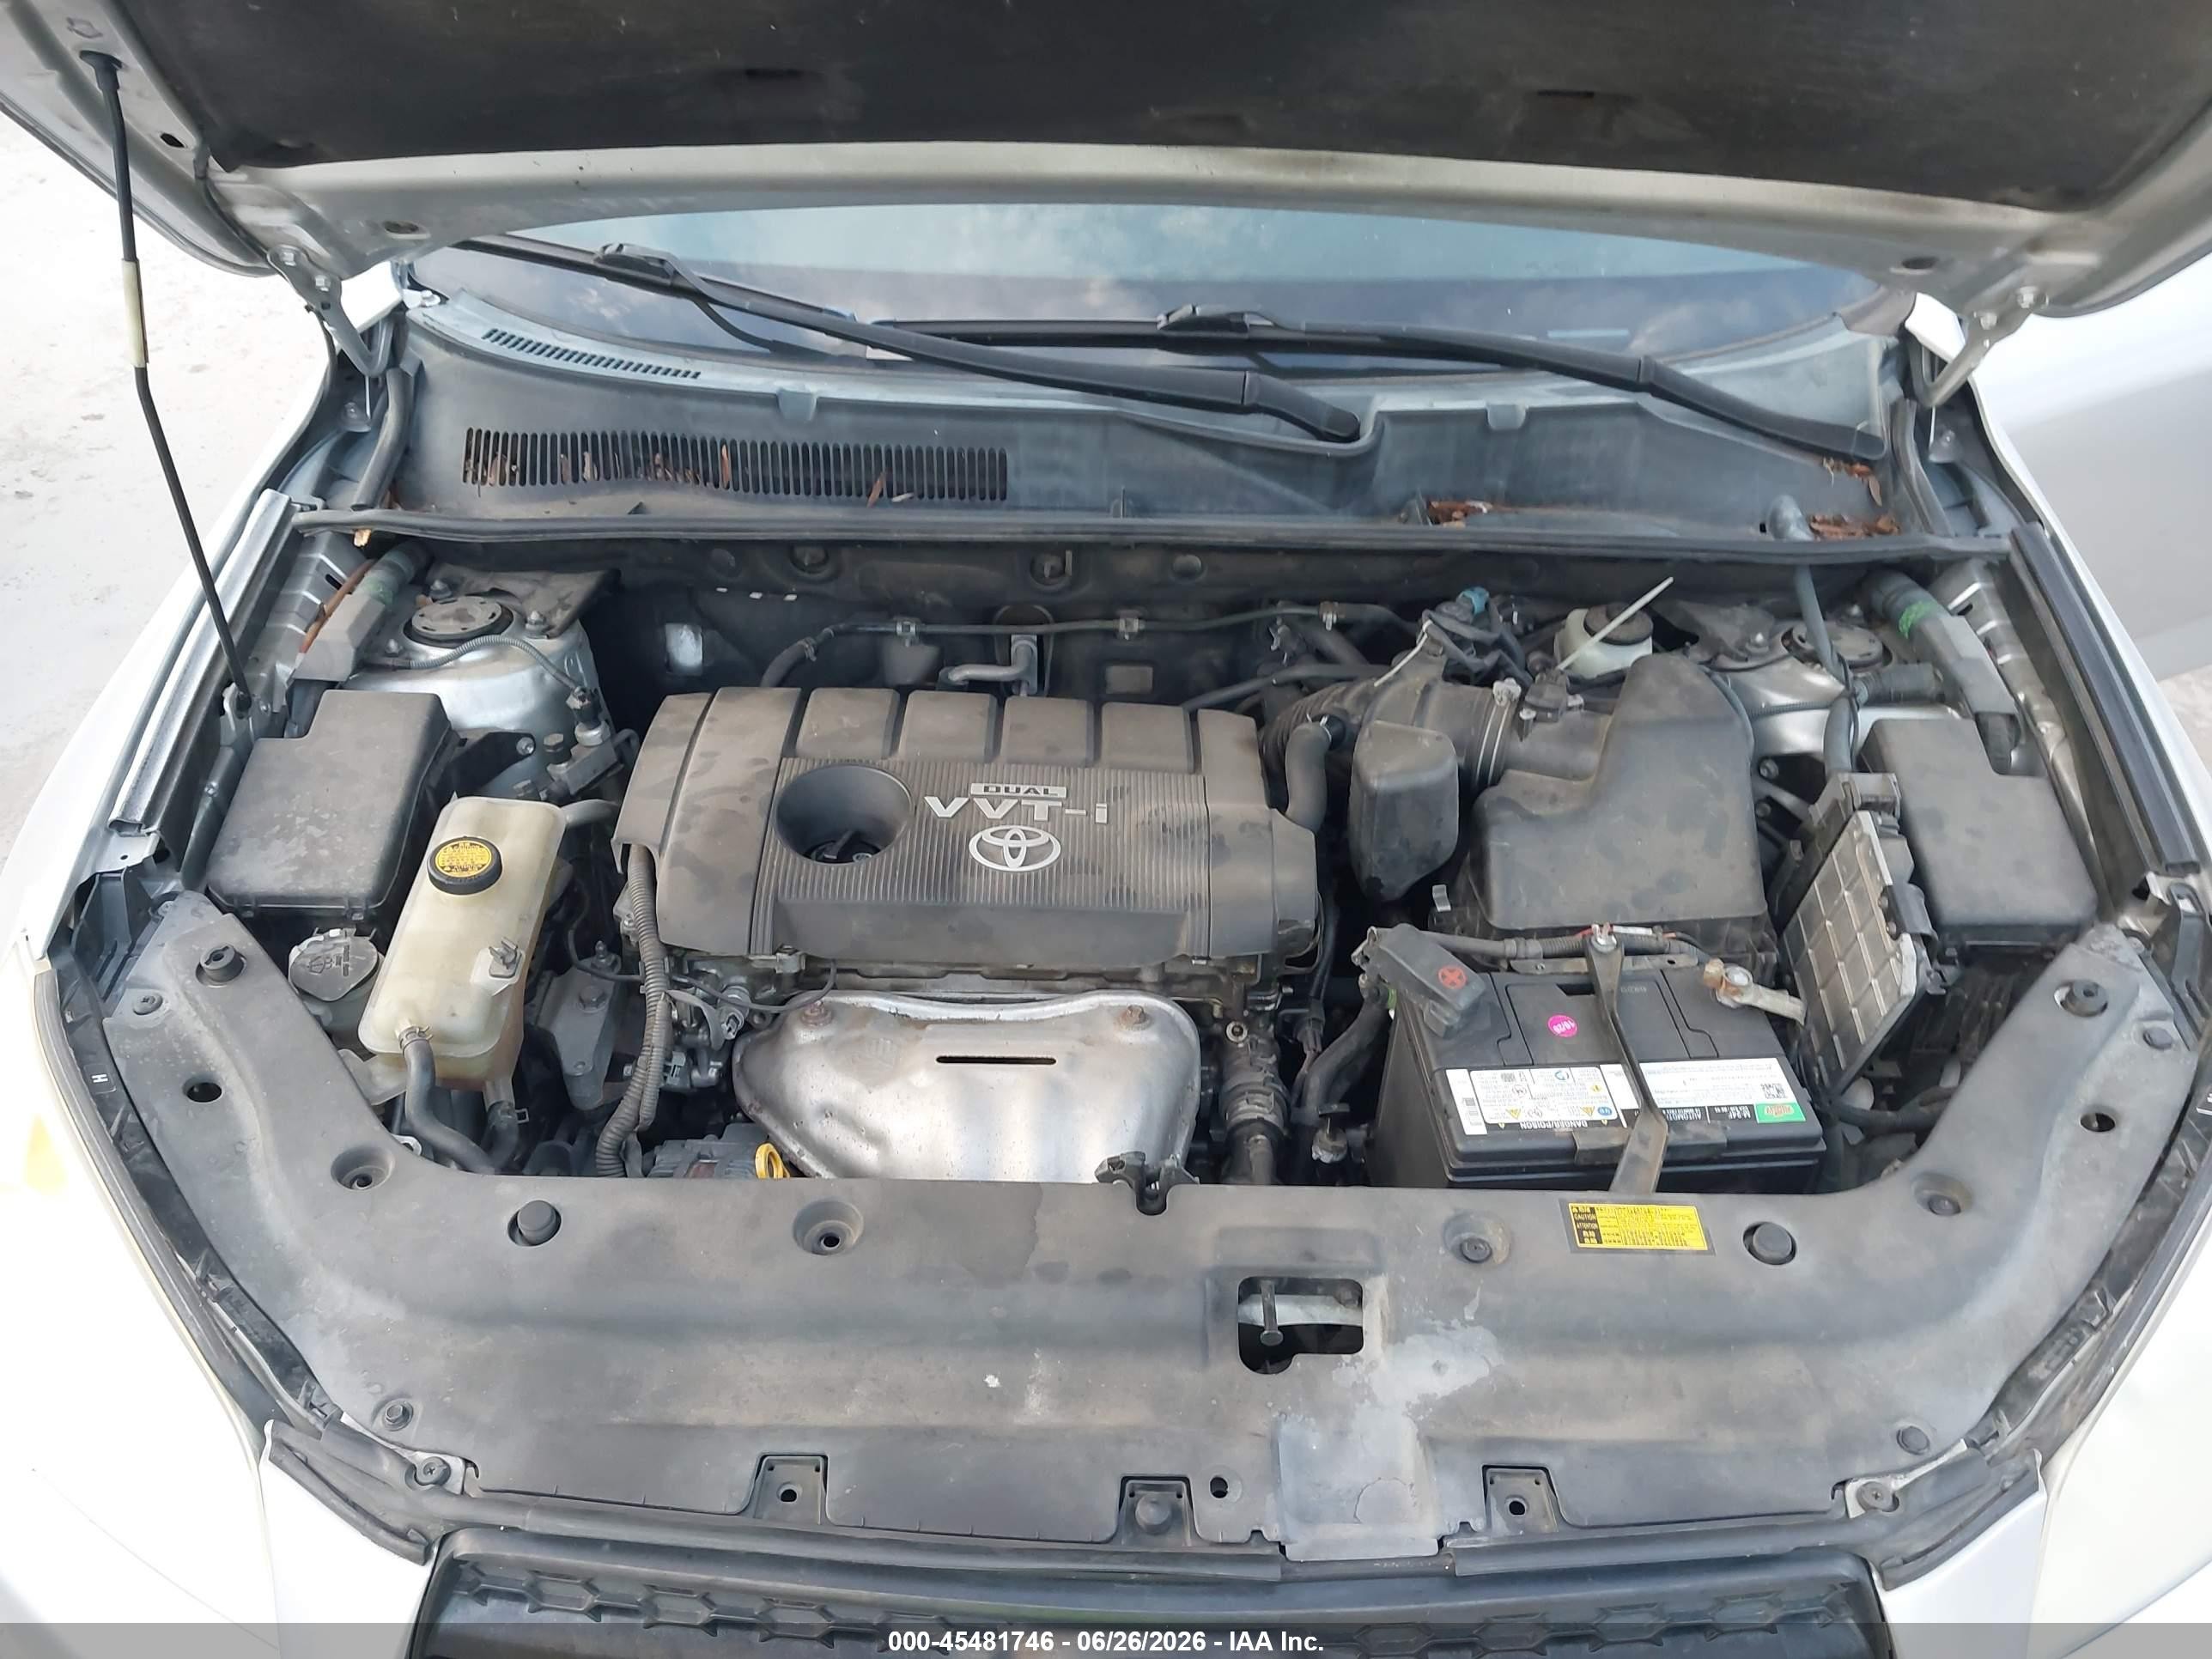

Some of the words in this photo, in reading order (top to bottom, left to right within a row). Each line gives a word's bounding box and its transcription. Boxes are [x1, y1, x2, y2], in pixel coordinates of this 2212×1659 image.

[979, 783, 1061, 797] DUAL
[924, 795, 1108, 823] VVT-i
[1666, 1111, 1702, 1121] AUTOMOTI
